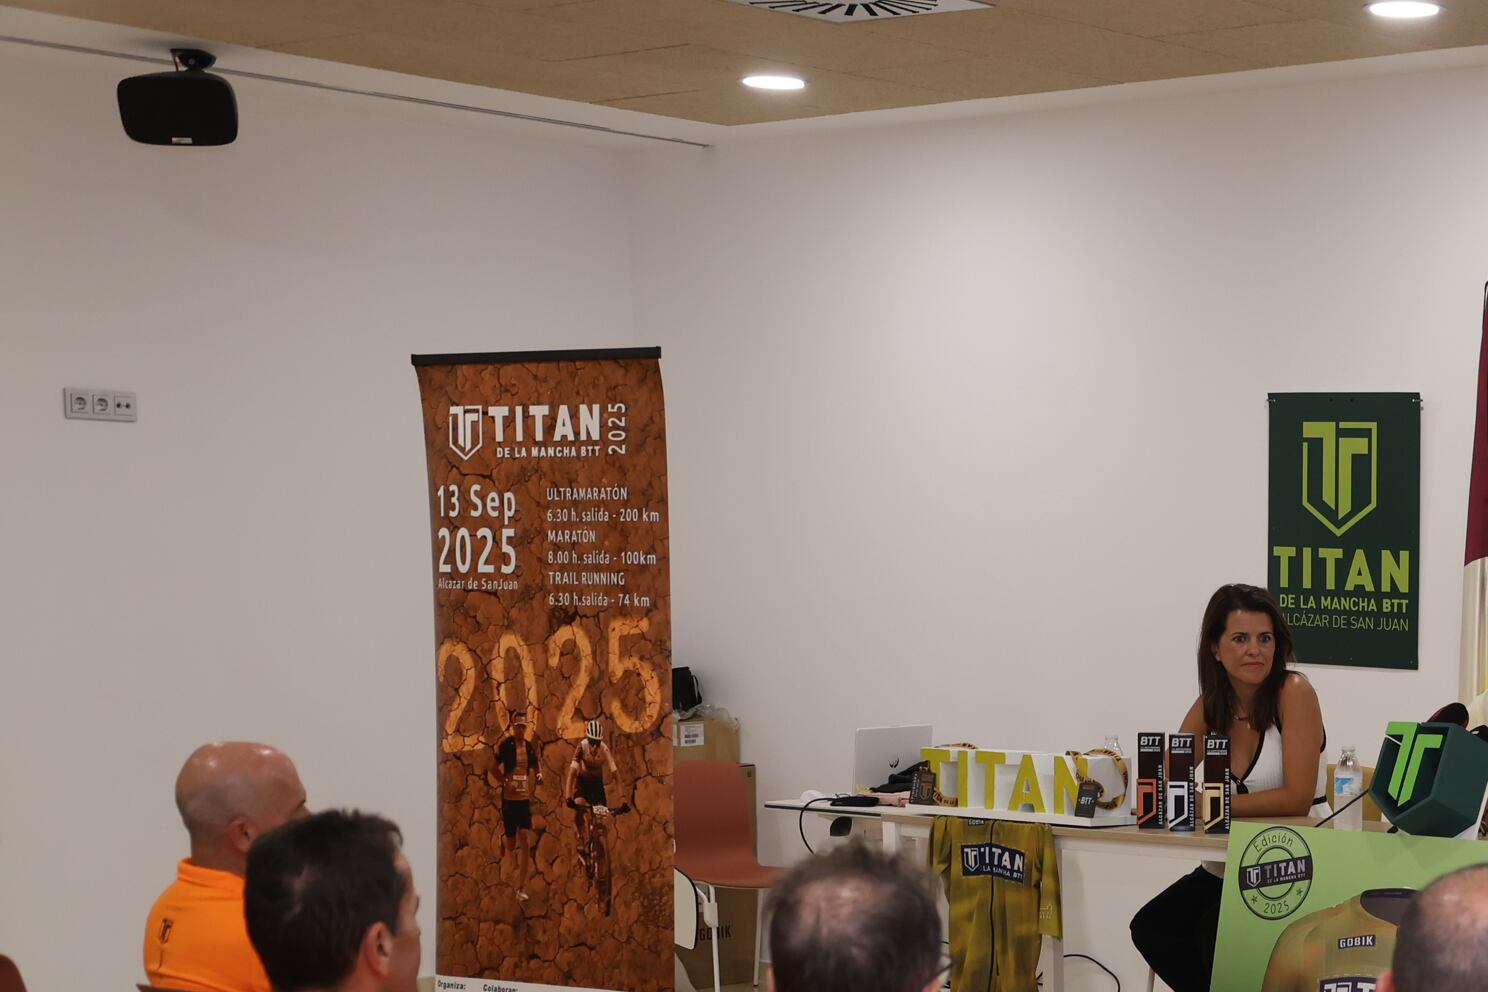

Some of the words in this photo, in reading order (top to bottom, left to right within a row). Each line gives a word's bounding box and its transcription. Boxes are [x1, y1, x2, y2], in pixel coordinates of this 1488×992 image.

[488, 403, 601, 442] TITAN
[608, 402, 626, 455] 2025
[496, 447, 511, 458] DE
[514, 446, 527, 458] LA
[531, 446, 577, 458] MANCHA
[580, 445, 600, 457] BTT
[546, 484, 628, 501] ULTRAMARATÓN
[437, 484, 460, 518] 13
[470, 483, 516, 525] Sep
[547, 509, 568, 522] 6.30
[571, 508, 580, 522] h.
[582, 508, 609, 522] salida
[620, 509, 638, 522] 200
[642, 509, 660, 523] km
[547, 527, 596, 543] MARATÓN
[438, 527, 517, 575] 2025
[548, 551, 569, 564] 8.00
[572, 551, 580, 564] h.
[583, 551, 610, 564] salida
[621, 551, 657, 565] 100km
[1273, 545, 1410, 593] TITAN
[467, 577, 478, 590] de
[548, 571, 579, 586] TRAIL
[582, 571, 625, 586] RUNNING
[549, 594, 570, 607] 6.30
[618, 594, 630, 607] 74
[633, 594, 650, 608] km
[1279, 593, 1296, 608] DE
[1300, 594, 1316, 609] LA
[1320, 595, 1378, 612] MANCHA
[1382, 598, 1409, 613] BTT
[1332, 614, 1348, 629] DE
[1350, 616, 1374, 630] SAN
[1377, 617, 1409, 632] JUAN
[438, 617, 662, 753] 2025
[1140, 736, 1161, 746] BTT
[1171, 737, 1193, 748] BTT
[1206, 739, 1228, 749] BTT
[920, 747, 1088, 816] TITAN
[1252, 832, 1294, 853] Edición
[1263, 859, 1306, 878] TITAN
[1263, 900, 1290, 914] 2025
[1339, 935, 1374, 948] GOBIK
[437, 980, 466, 990] Organiza:
